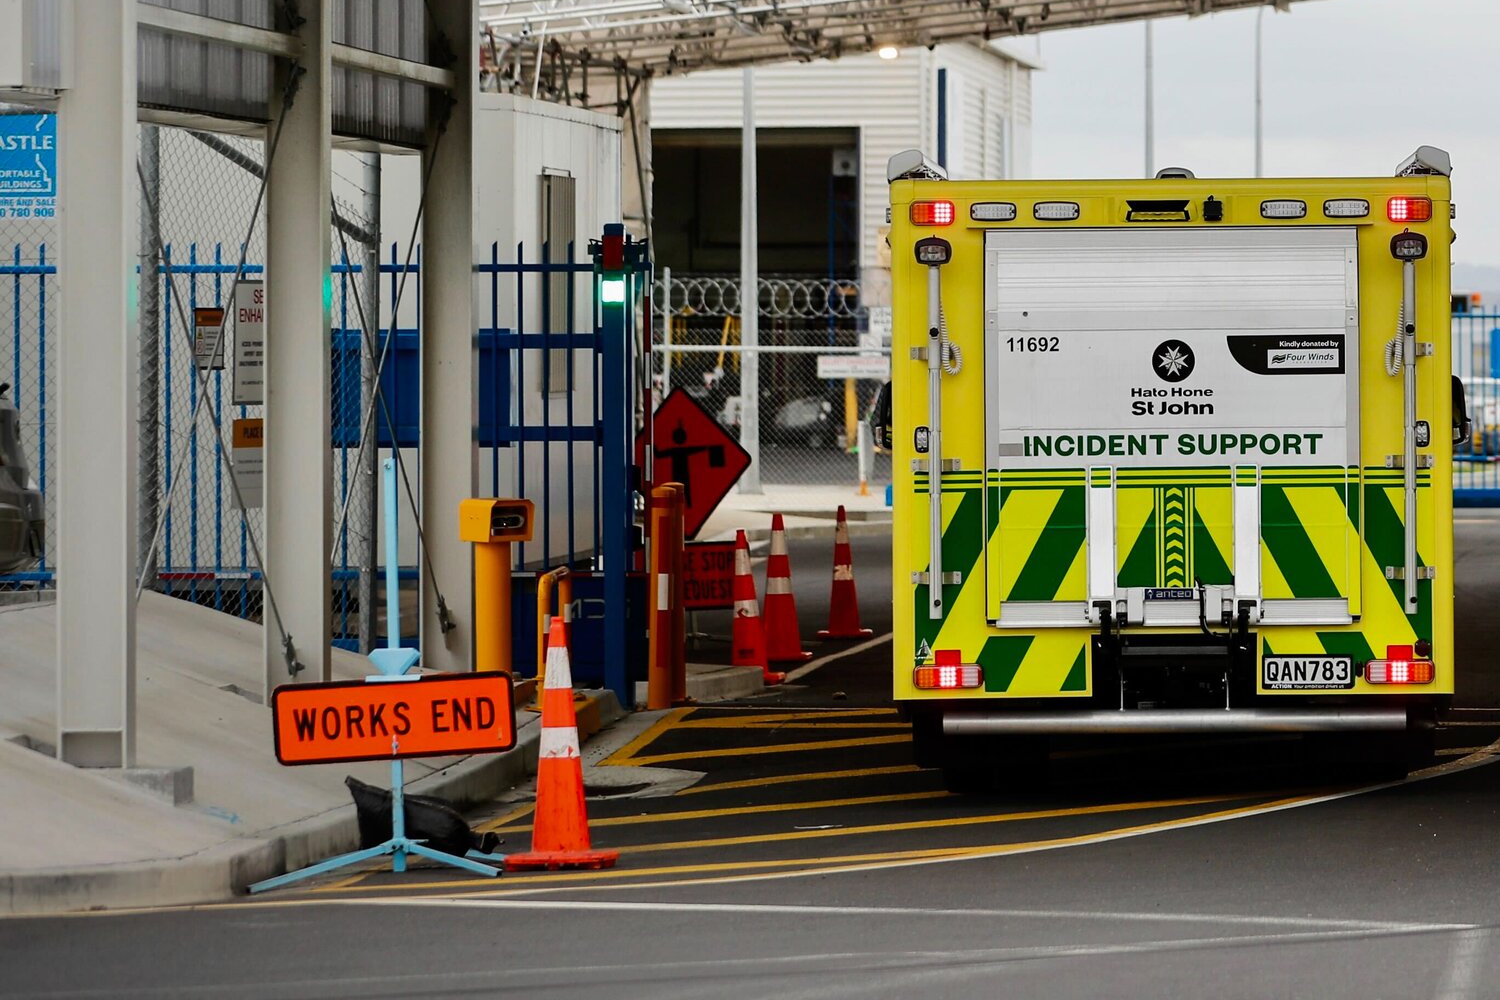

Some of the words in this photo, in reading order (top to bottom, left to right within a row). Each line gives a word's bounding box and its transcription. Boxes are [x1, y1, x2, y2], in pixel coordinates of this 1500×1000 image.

[36, 198, 56, 206] SALE
[239, 308, 263, 322] ENHA
[1006, 337, 1060, 352] 11692
[1279, 340, 1301, 348] Kindly
[1286, 353, 1306, 361] Four
[1308, 352, 1334, 361] Winds
[1131, 387, 1168, 397] Hato
[1171, 387, 1214, 397] Hone
[1131, 401, 1155, 416] St
[1158, 401, 1214, 415] John
[1023, 434, 1169, 457] INCIDENT
[1177, 433, 1323, 456] SUPPORT
[702, 551, 734, 571] STOP
[1155, 590, 1192, 598] anteo
[1267, 661, 1348, 681] QAN783
[293, 701, 411, 742] WORKS
[431, 697, 495, 733] END
